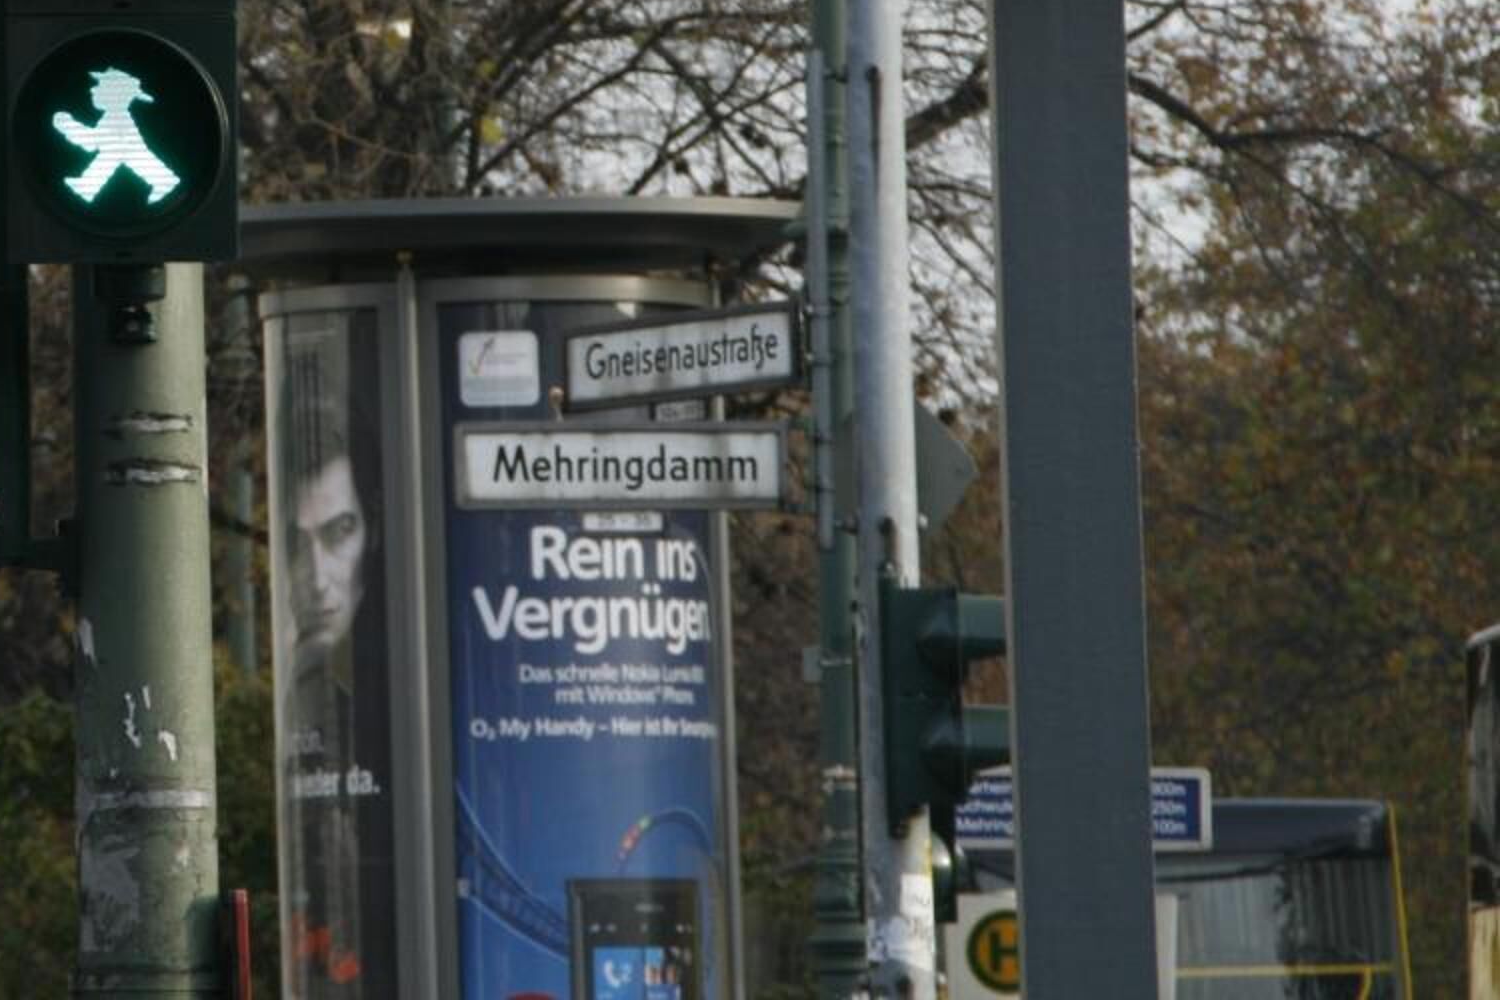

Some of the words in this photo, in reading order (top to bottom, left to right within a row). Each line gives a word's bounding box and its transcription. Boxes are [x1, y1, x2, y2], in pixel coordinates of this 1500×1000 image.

[585, 327, 779, 381] Gneisenaustraße
[493, 443, 759, 492] Mehringdamm
[530, 525, 645, 581] Rein
[657, 538, 698, 581] ins
[472, 583, 710, 655] Vergnügen
[519, 664, 551, 683] Das
[555, 685, 584, 704] mit
[501, 718, 532, 741] My
[535, 716, 595, 741] Handy
[346, 764, 381, 796] da.
